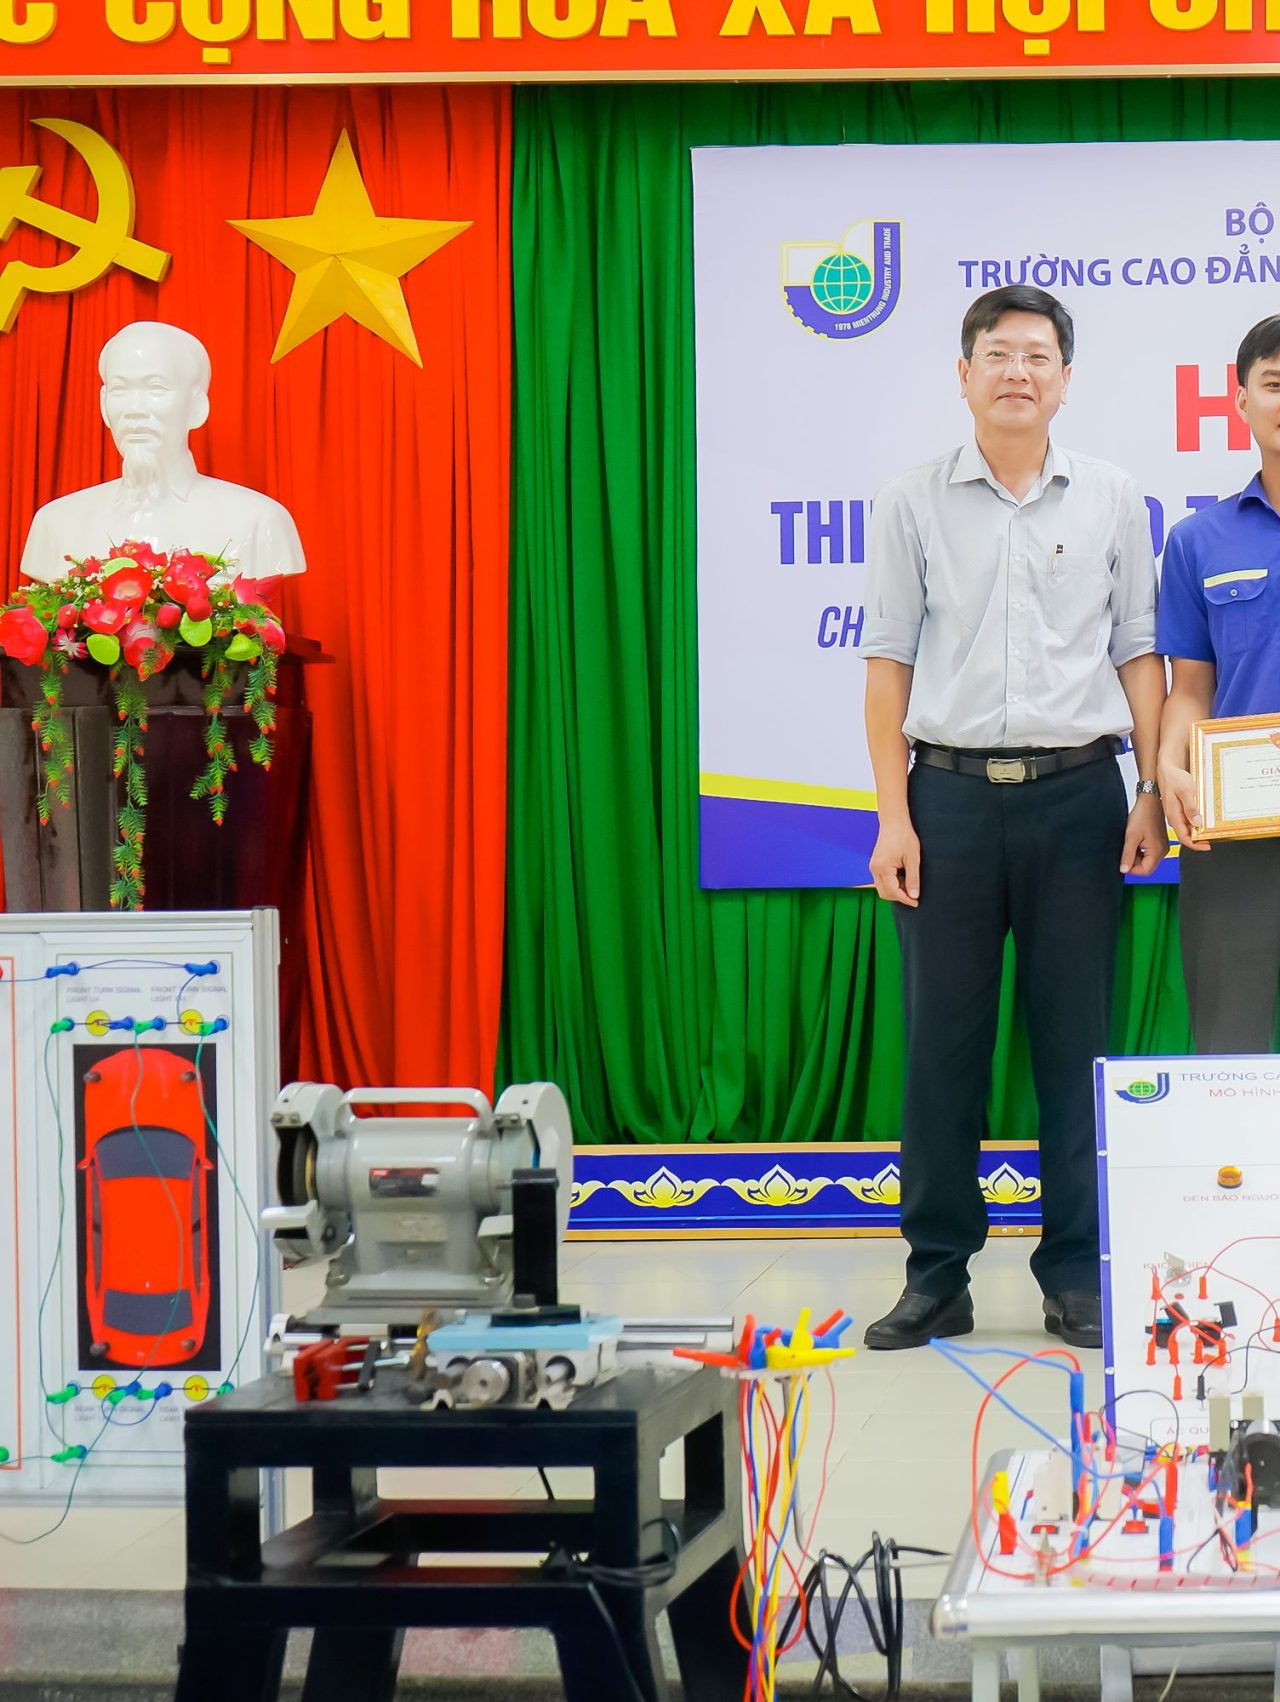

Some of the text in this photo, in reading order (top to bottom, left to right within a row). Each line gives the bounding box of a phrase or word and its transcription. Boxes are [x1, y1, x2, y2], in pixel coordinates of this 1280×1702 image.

[1225, 202, 1274, 243] BỘ
[883, 227, 891, 250] TRADE
[883, 251, 892, 265] AND
[958, 253, 1111, 288] TRƯỜNG
[1121, 257, 1197, 286] CAO
[771, 500, 872, 565] THI
[1189, 1425, 1209, 1435] QU
